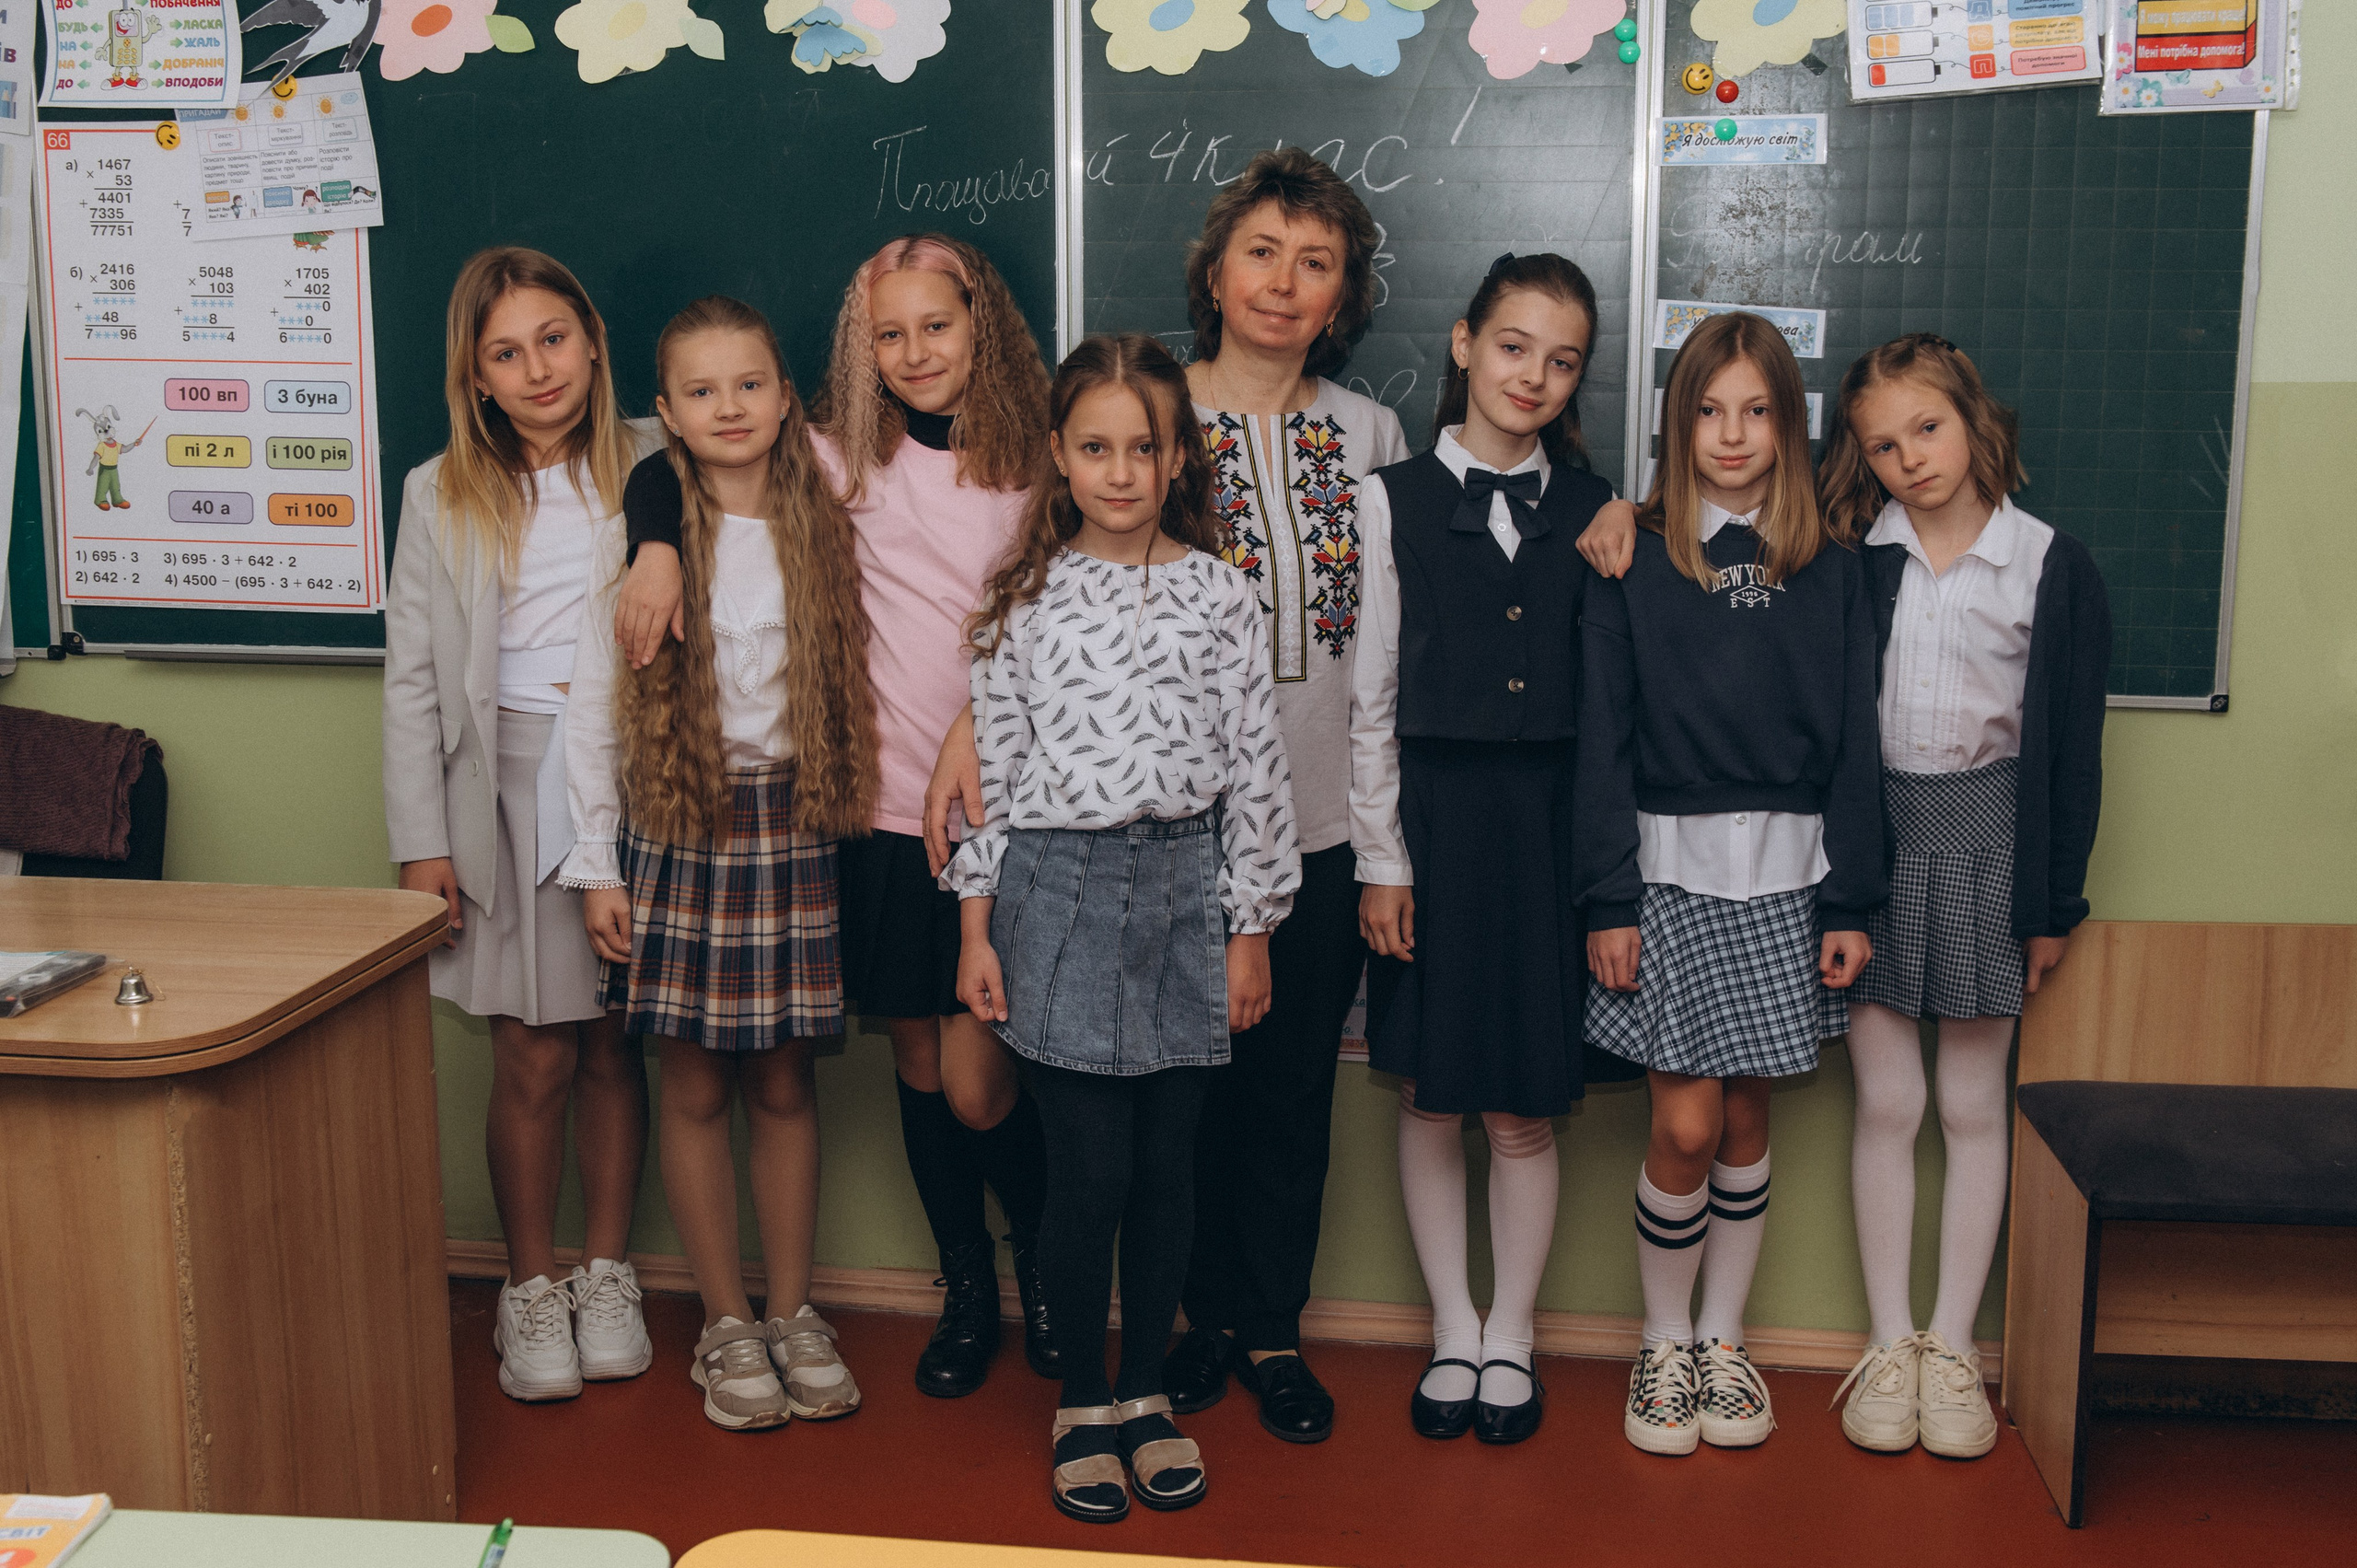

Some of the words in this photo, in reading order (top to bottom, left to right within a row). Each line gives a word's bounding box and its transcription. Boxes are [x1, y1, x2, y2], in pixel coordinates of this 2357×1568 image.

[58, 22, 88, 34] БУДЬ
[182, 19, 224, 30] ЛАСКА
[60, 41, 77, 52] НА
[184, 37, 221, 48] ЖАЛЬ
[2137, 45, 2159, 59] Мені
[2160, 43, 2199, 61] потрібна
[2200, 41, 2246, 59] допомога!
[58, 59, 75, 69] НА
[162, 58, 225, 71] ДОБРАНІЧ
[1973, 58, 1993, 74] П
[56, 79, 74, 89] ДО
[165, 77, 224, 88] ВПОДОБИ
[47, 132, 68, 148] 66
[1681, 134, 1693, 147] Я
[1768, 131, 1799, 145] світ
[319, 146, 350, 155] Розповісти
[66, 160, 77, 171] а)
[99, 159, 131, 169] 1467
[203, 156, 226, 164] Описати
[116, 175, 132, 186] 53
[99, 192, 130, 203] 4401
[90, 208, 123, 219] 7335
[91, 225, 132, 236] 77751
[70, 266, 83, 280] б)
[100, 263, 134, 274] 2416
[200, 267, 233, 278] 5048
[296, 268, 329, 279] 1705
[110, 279, 135, 290] 306
[210, 283, 234, 294] 103
[305, 284, 330, 295] 402
[180, 387, 210, 401] 100
[217, 391, 237, 401] вп
[296, 389, 337, 407] буна
[185, 443, 199, 457] пі
[207, 443, 216, 457] 2
[224, 447, 234, 457] л
[273, 446, 276, 459] і
[284, 445, 315, 459] 100
[321, 447, 346, 462] рія
[192, 501, 214, 514] 40
[221, 505, 229, 515] а
[284, 504, 298, 517] ті
[306, 504, 337, 517] 100
[76, 551, 87, 563] 1)
[92, 551, 116, 562] 695
[132, 552, 138, 563] 3
[164, 552, 177, 565] 3)
[182, 553, 207, 564] 695
[222, 554, 229, 565] 3
[249, 555, 273, 566] 642
[289, 556, 296, 567] 2
[76, 571, 87, 584] 2)
[93, 572, 117, 583] 642
[133, 573, 139, 583] 2
[165, 575, 178, 587] 4)
[183, 575, 216, 586] 4500
[236, 576, 265, 588] (695
[281, 577, 288, 588] 3
[308, 578, 332, 589] 642
[348, 580, 361, 592] 2)
[1744, 563, 1786, 592] YO
